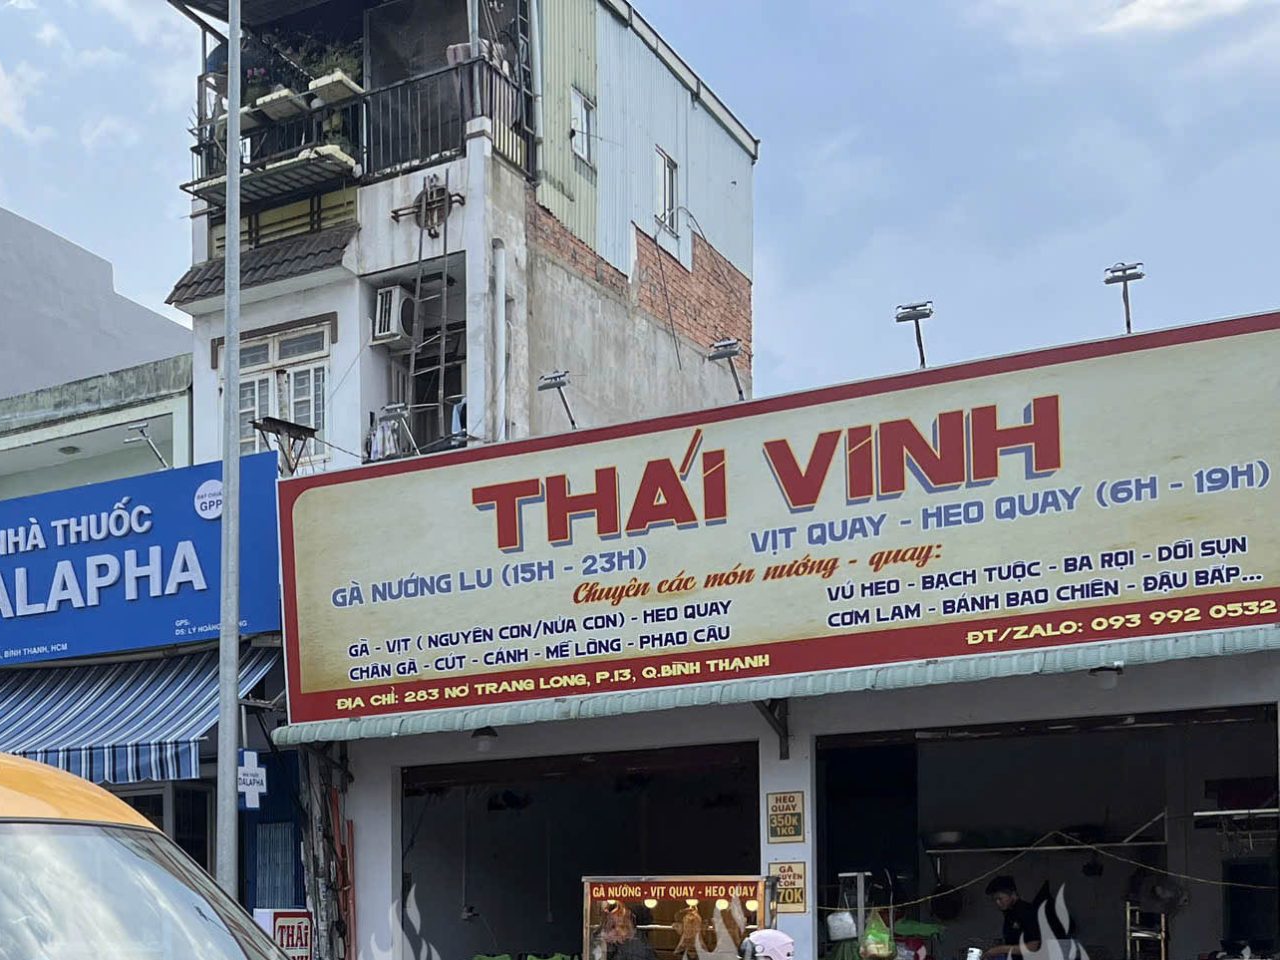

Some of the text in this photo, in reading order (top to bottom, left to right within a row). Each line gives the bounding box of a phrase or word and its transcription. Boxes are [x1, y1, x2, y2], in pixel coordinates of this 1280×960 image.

[471, 394, 1062, 553] THÁI VINH
[51, 496, 153, 547] THUỐC
[200, 499, 223, 512] GPP
[750, 460, 1271, 555] VỊT QUAY HEO QUAY (6H 19H)
[332, 545, 648, 609] GÀ NƯỚNG LU (15H 23H)
[573, 576, 651, 607] Chuyên
[657, 569, 696, 594] các
[703, 562, 755, 590] món
[763, 546, 839, 581] nướng
[827, 579, 856, 602] VÚ
[861, 578, 900, 599] HEO
[922, 569, 977, 592] BẠCH
[983, 559, 1042, 583] TUỘC
[1064, 556, 1094, 575] BA
[1100, 549, 1135, 573] RỌI
[1201, 536, 1248, 559] SỤN
[827, 605, 871, 628] CƠM
[876, 602, 921, 622] LAM
[942, 591, 1000, 616] BÁNH
[1006, 588, 1050, 607] BAO
[1056, 577, 1120, 602] CHIÊN
[1142, 571, 1188, 594] ĐẬU
[966, 599, 1279, 646] ĐT/ZALO: 093 992 0532
[348, 636, 370, 659] GÀ
[385, 637, 412, 656] VỊT
[427, 626, 494, 650] NGUYÊN
[582, 612, 626, 633] CON)
[642, 606, 679, 625] HEO
[683, 601, 732, 622] QUAY
[349, 660, 392, 682] CHÂN
[396, 655, 418, 678] GÀ
[434, 651, 466, 673] CÚT
[483, 644, 529, 667] CÁNH
[575, 637, 622, 658] LÒNG
[639, 631, 689, 652] PHAO
[693, 624, 732, 645] CÂU
[336, 697, 366, 713] ĐỊA
[404, 687, 440, 704] 283
[444, 683, 470, 701] NƠ
[474, 678, 535, 696] TRANG
[540, 672, 592, 692] LONG,
[641, 660, 702, 682] Q.BÌNH
[706, 653, 771, 676] THẠNH
[770, 814, 798, 827] 350K
[771, 803, 797, 813] QUAY
[775, 795, 795, 804] HEO
[776, 826, 795, 836] 1KG
[593, 884, 756, 900] GÀ NƯỚNG VỊT QUAY HEO QUAY
[278, 921, 309, 948] THÁI
